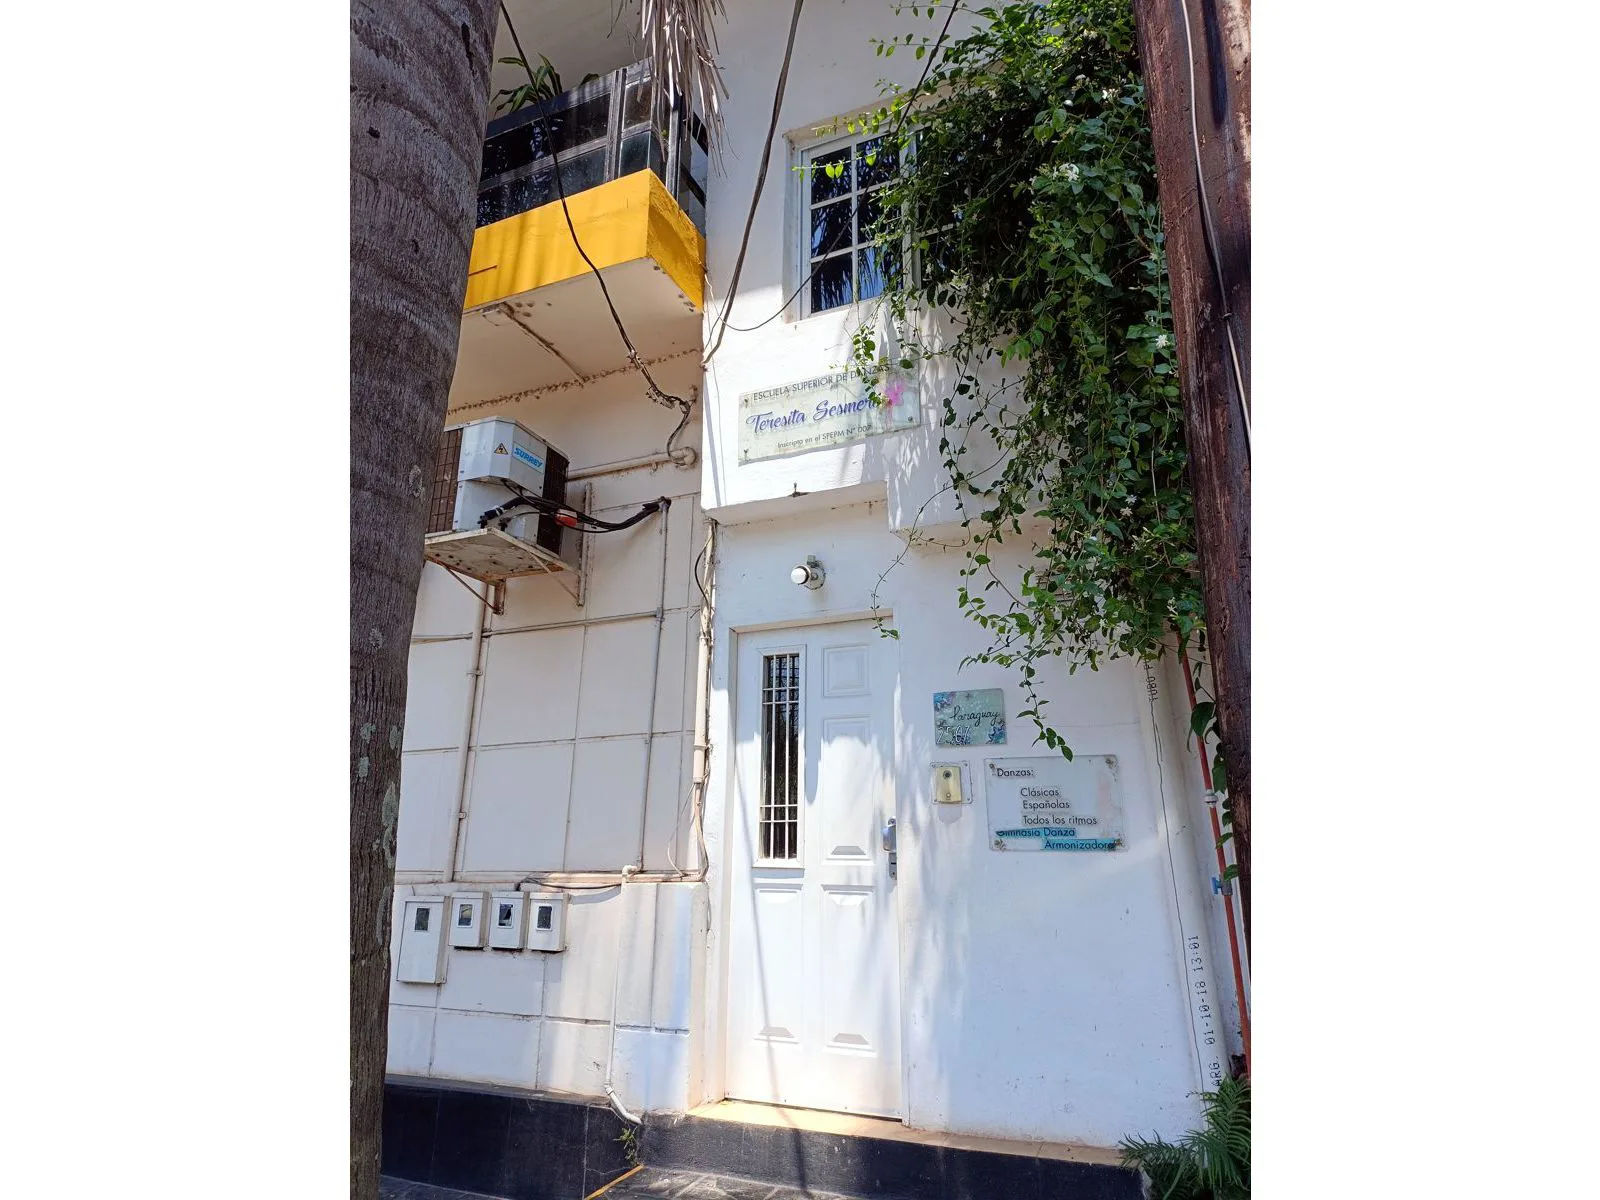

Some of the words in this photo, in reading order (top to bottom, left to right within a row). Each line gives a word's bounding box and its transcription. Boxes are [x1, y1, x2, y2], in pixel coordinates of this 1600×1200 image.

[753, 386, 790, 400] ESCUELA
[792, 377, 833, 391] SUPERIOR
[836, 373, 847, 383] DE
[851, 365, 889, 380] DNZAS
[746, 409, 805, 433] Teresita
[778, 440, 804, 449] Inscripto
[514, 447, 543, 468] SURREY
[950, 705, 1000, 727] Paraguay
[997, 768, 1034, 777] Danzas:
[1020, 787, 1060, 797] Clásicas
[1023, 800, 1070, 811] Españolas
[1023, 815, 1049, 825] Todos
[1052, 815, 1066, 824] los
[1068, 815, 1098, 825] ritmos
[1043, 827, 1076, 837] Danza
[1188, 935, 1204, 973] 13:01
